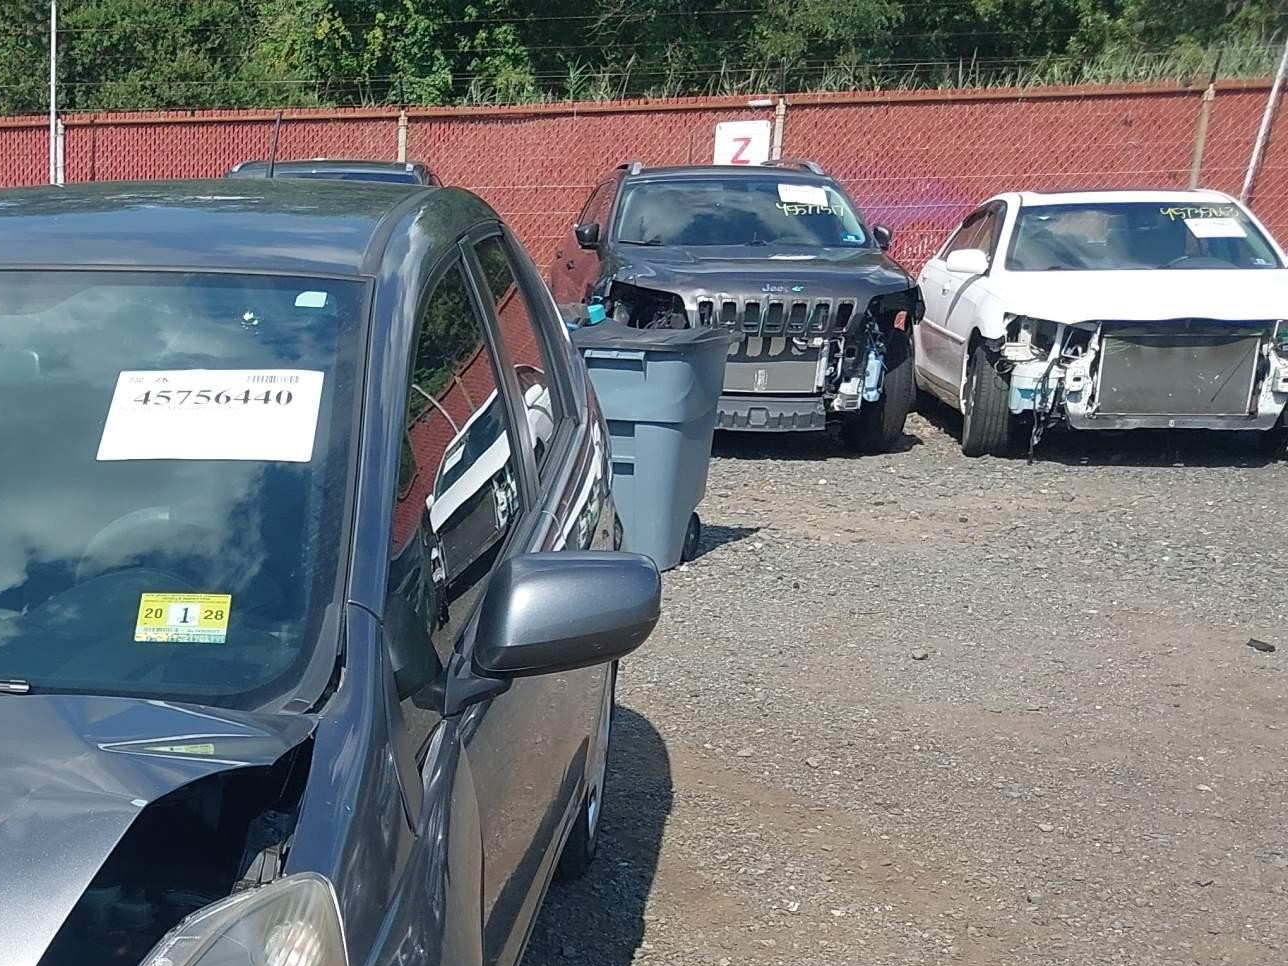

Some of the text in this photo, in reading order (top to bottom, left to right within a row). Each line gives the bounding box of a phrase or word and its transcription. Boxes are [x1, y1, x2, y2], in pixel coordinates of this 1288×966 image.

[731, 137, 752, 164] Z
[133, 389, 293, 406] 45756440
[144, 607, 224, 624] 20 1 28
